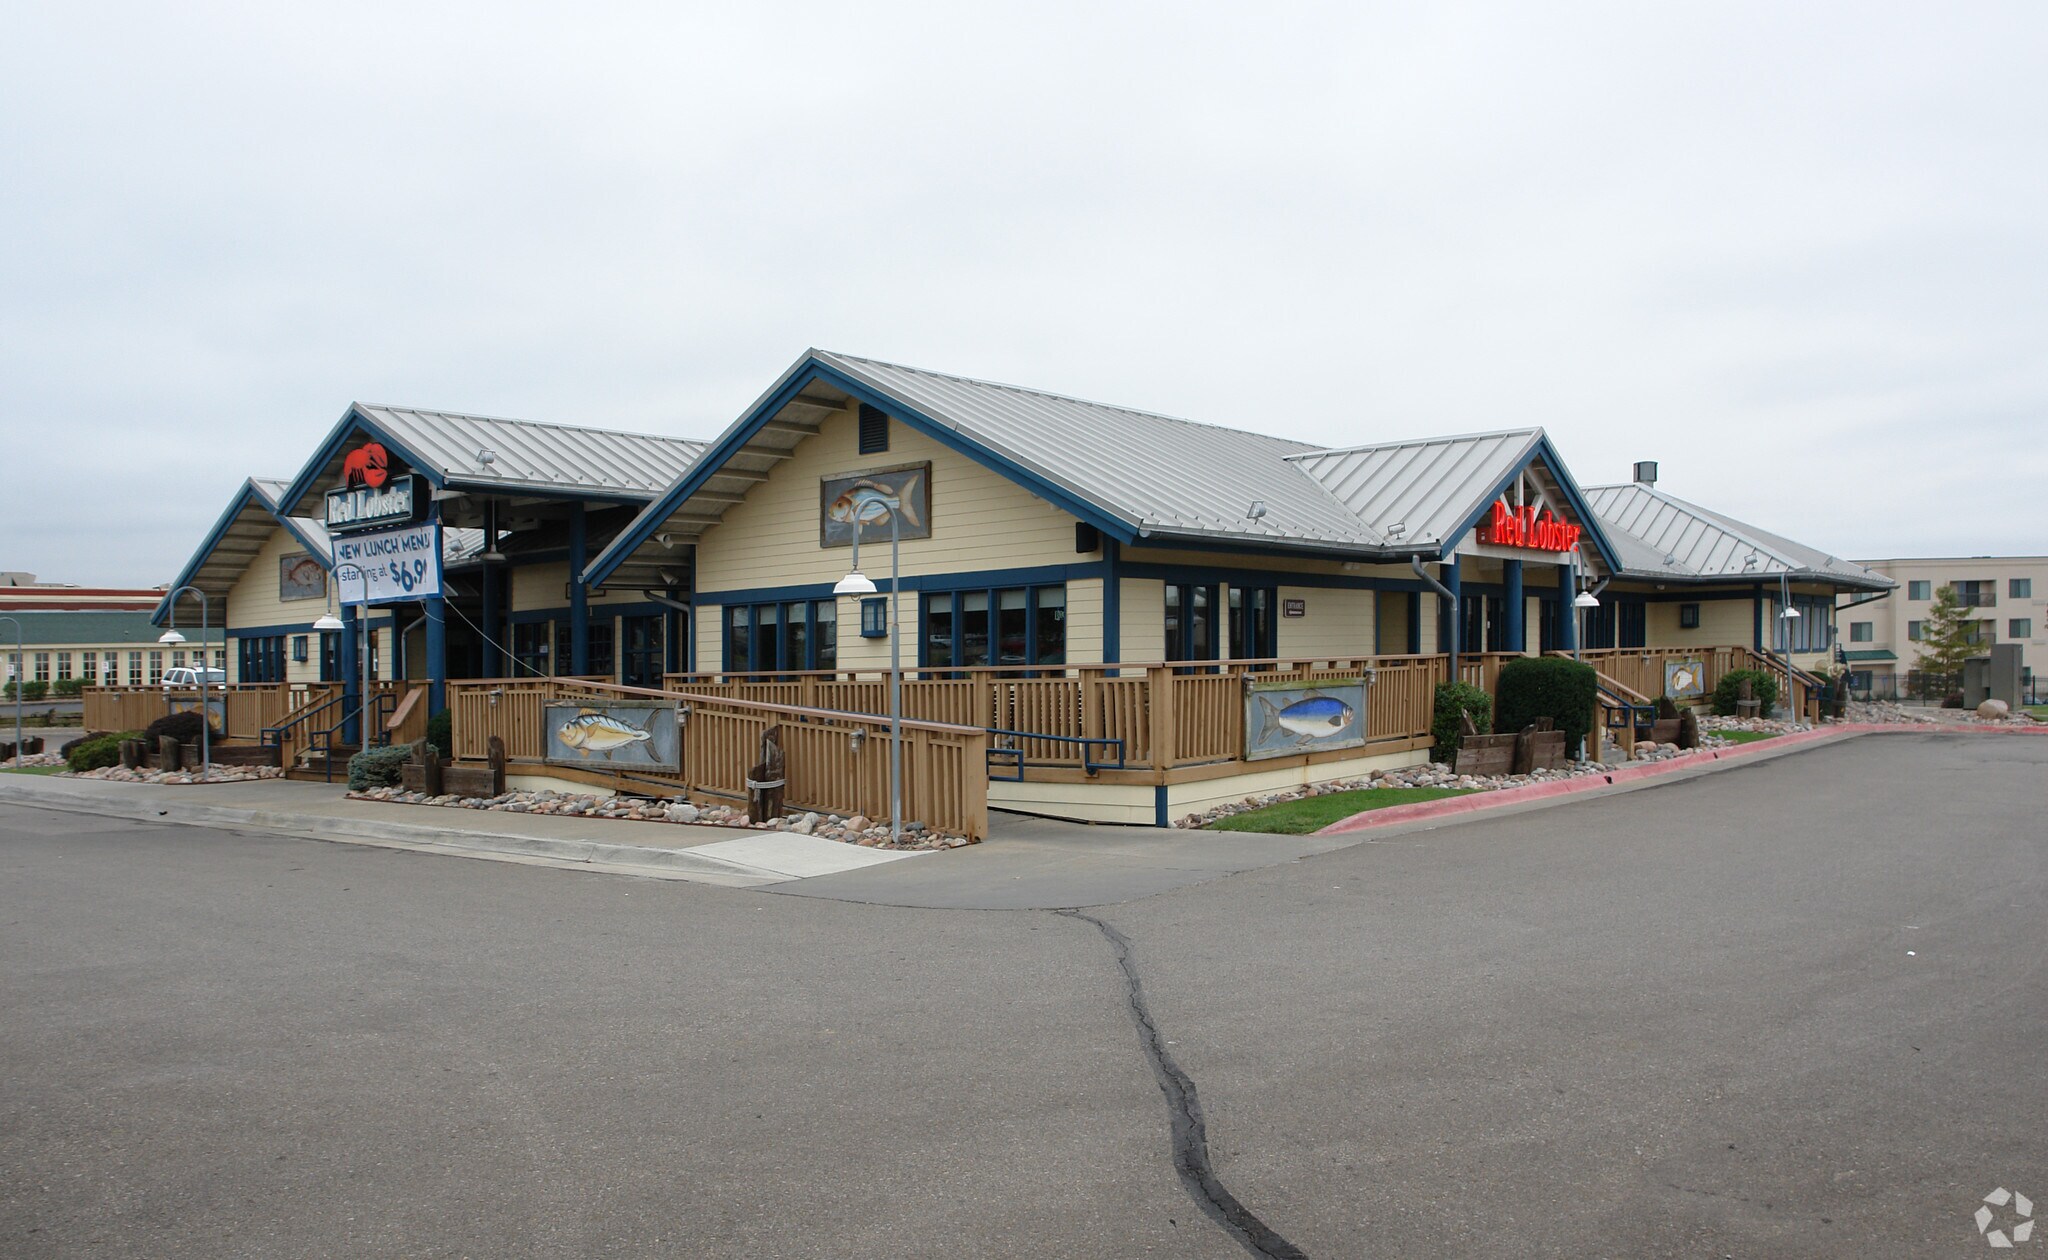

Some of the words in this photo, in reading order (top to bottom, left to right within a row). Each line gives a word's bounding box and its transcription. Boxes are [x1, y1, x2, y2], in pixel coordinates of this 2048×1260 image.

[328, 492, 355, 524] Red
[356, 486, 410, 518] Lobster
[1491, 499, 1524, 547] Red
[1525, 506, 1581, 553] Lobster
[339, 543, 361, 559] NEW
[364, 538, 400, 556] LUNCH
[402, 533, 430, 552] MENU
[341, 565, 379, 582] starng
[379, 563, 388, 577] at
